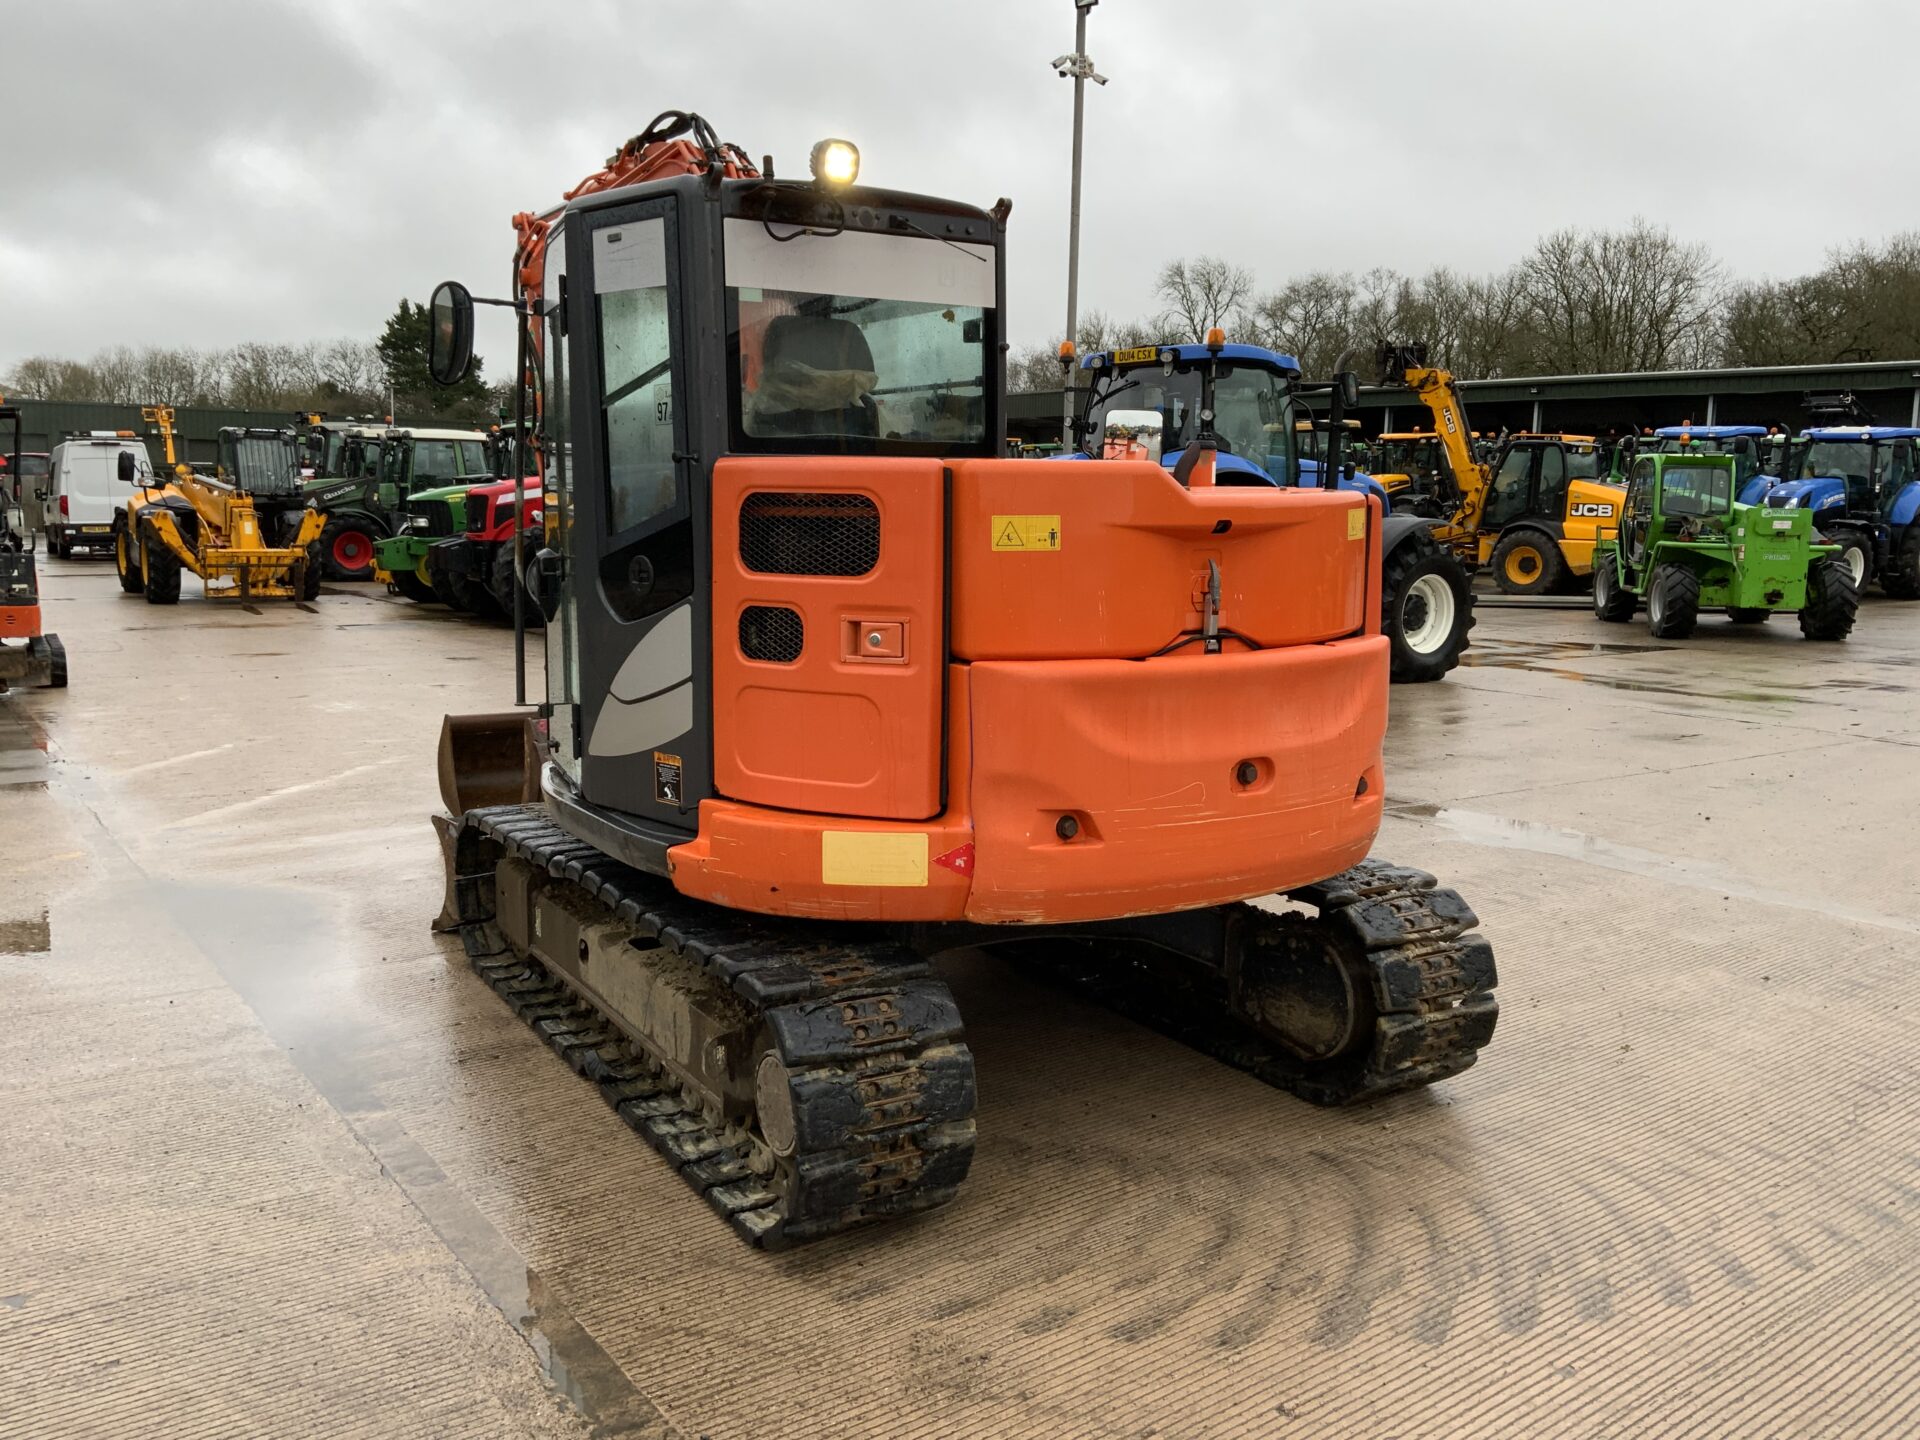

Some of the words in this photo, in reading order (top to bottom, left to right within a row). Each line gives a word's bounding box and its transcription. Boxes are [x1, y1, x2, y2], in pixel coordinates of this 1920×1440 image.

[657, 401, 668, 421] 97
[1443, 408, 1456, 434] JCB
[323, 485, 356, 500] Quicke
[1571, 503, 1613, 517] JCB
